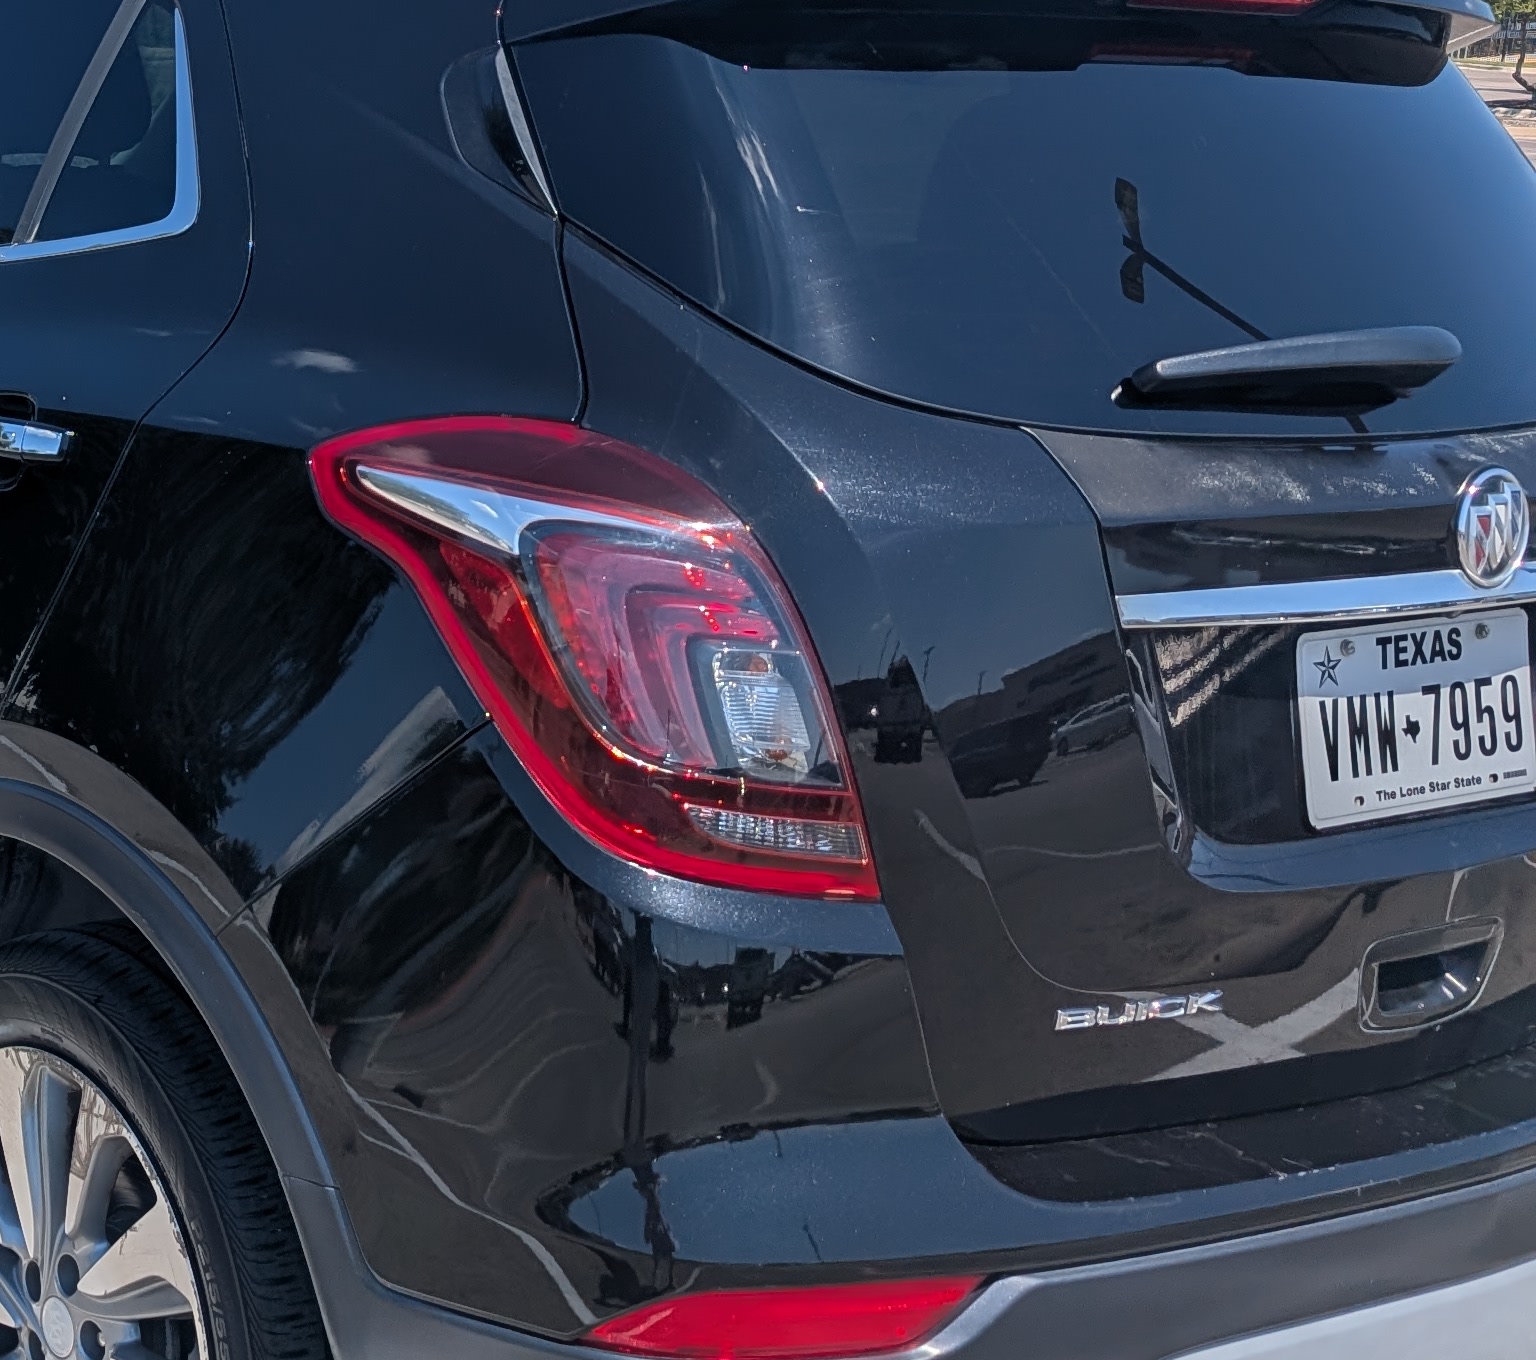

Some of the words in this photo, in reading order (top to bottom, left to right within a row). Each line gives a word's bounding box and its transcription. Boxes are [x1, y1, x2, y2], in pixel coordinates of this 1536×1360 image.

[1375, 627, 1463, 670] TEXAS
[1318, 690, 1399, 782] VMW
[1421, 674, 1524, 766] 7959
[1375, 787, 1397, 802] The
[1399, 784, 1426, 798] Lone
[1428, 780, 1452, 793] Star
[1453, 775, 1482, 789] State
[1054, 989, 1224, 1031] BUICK
